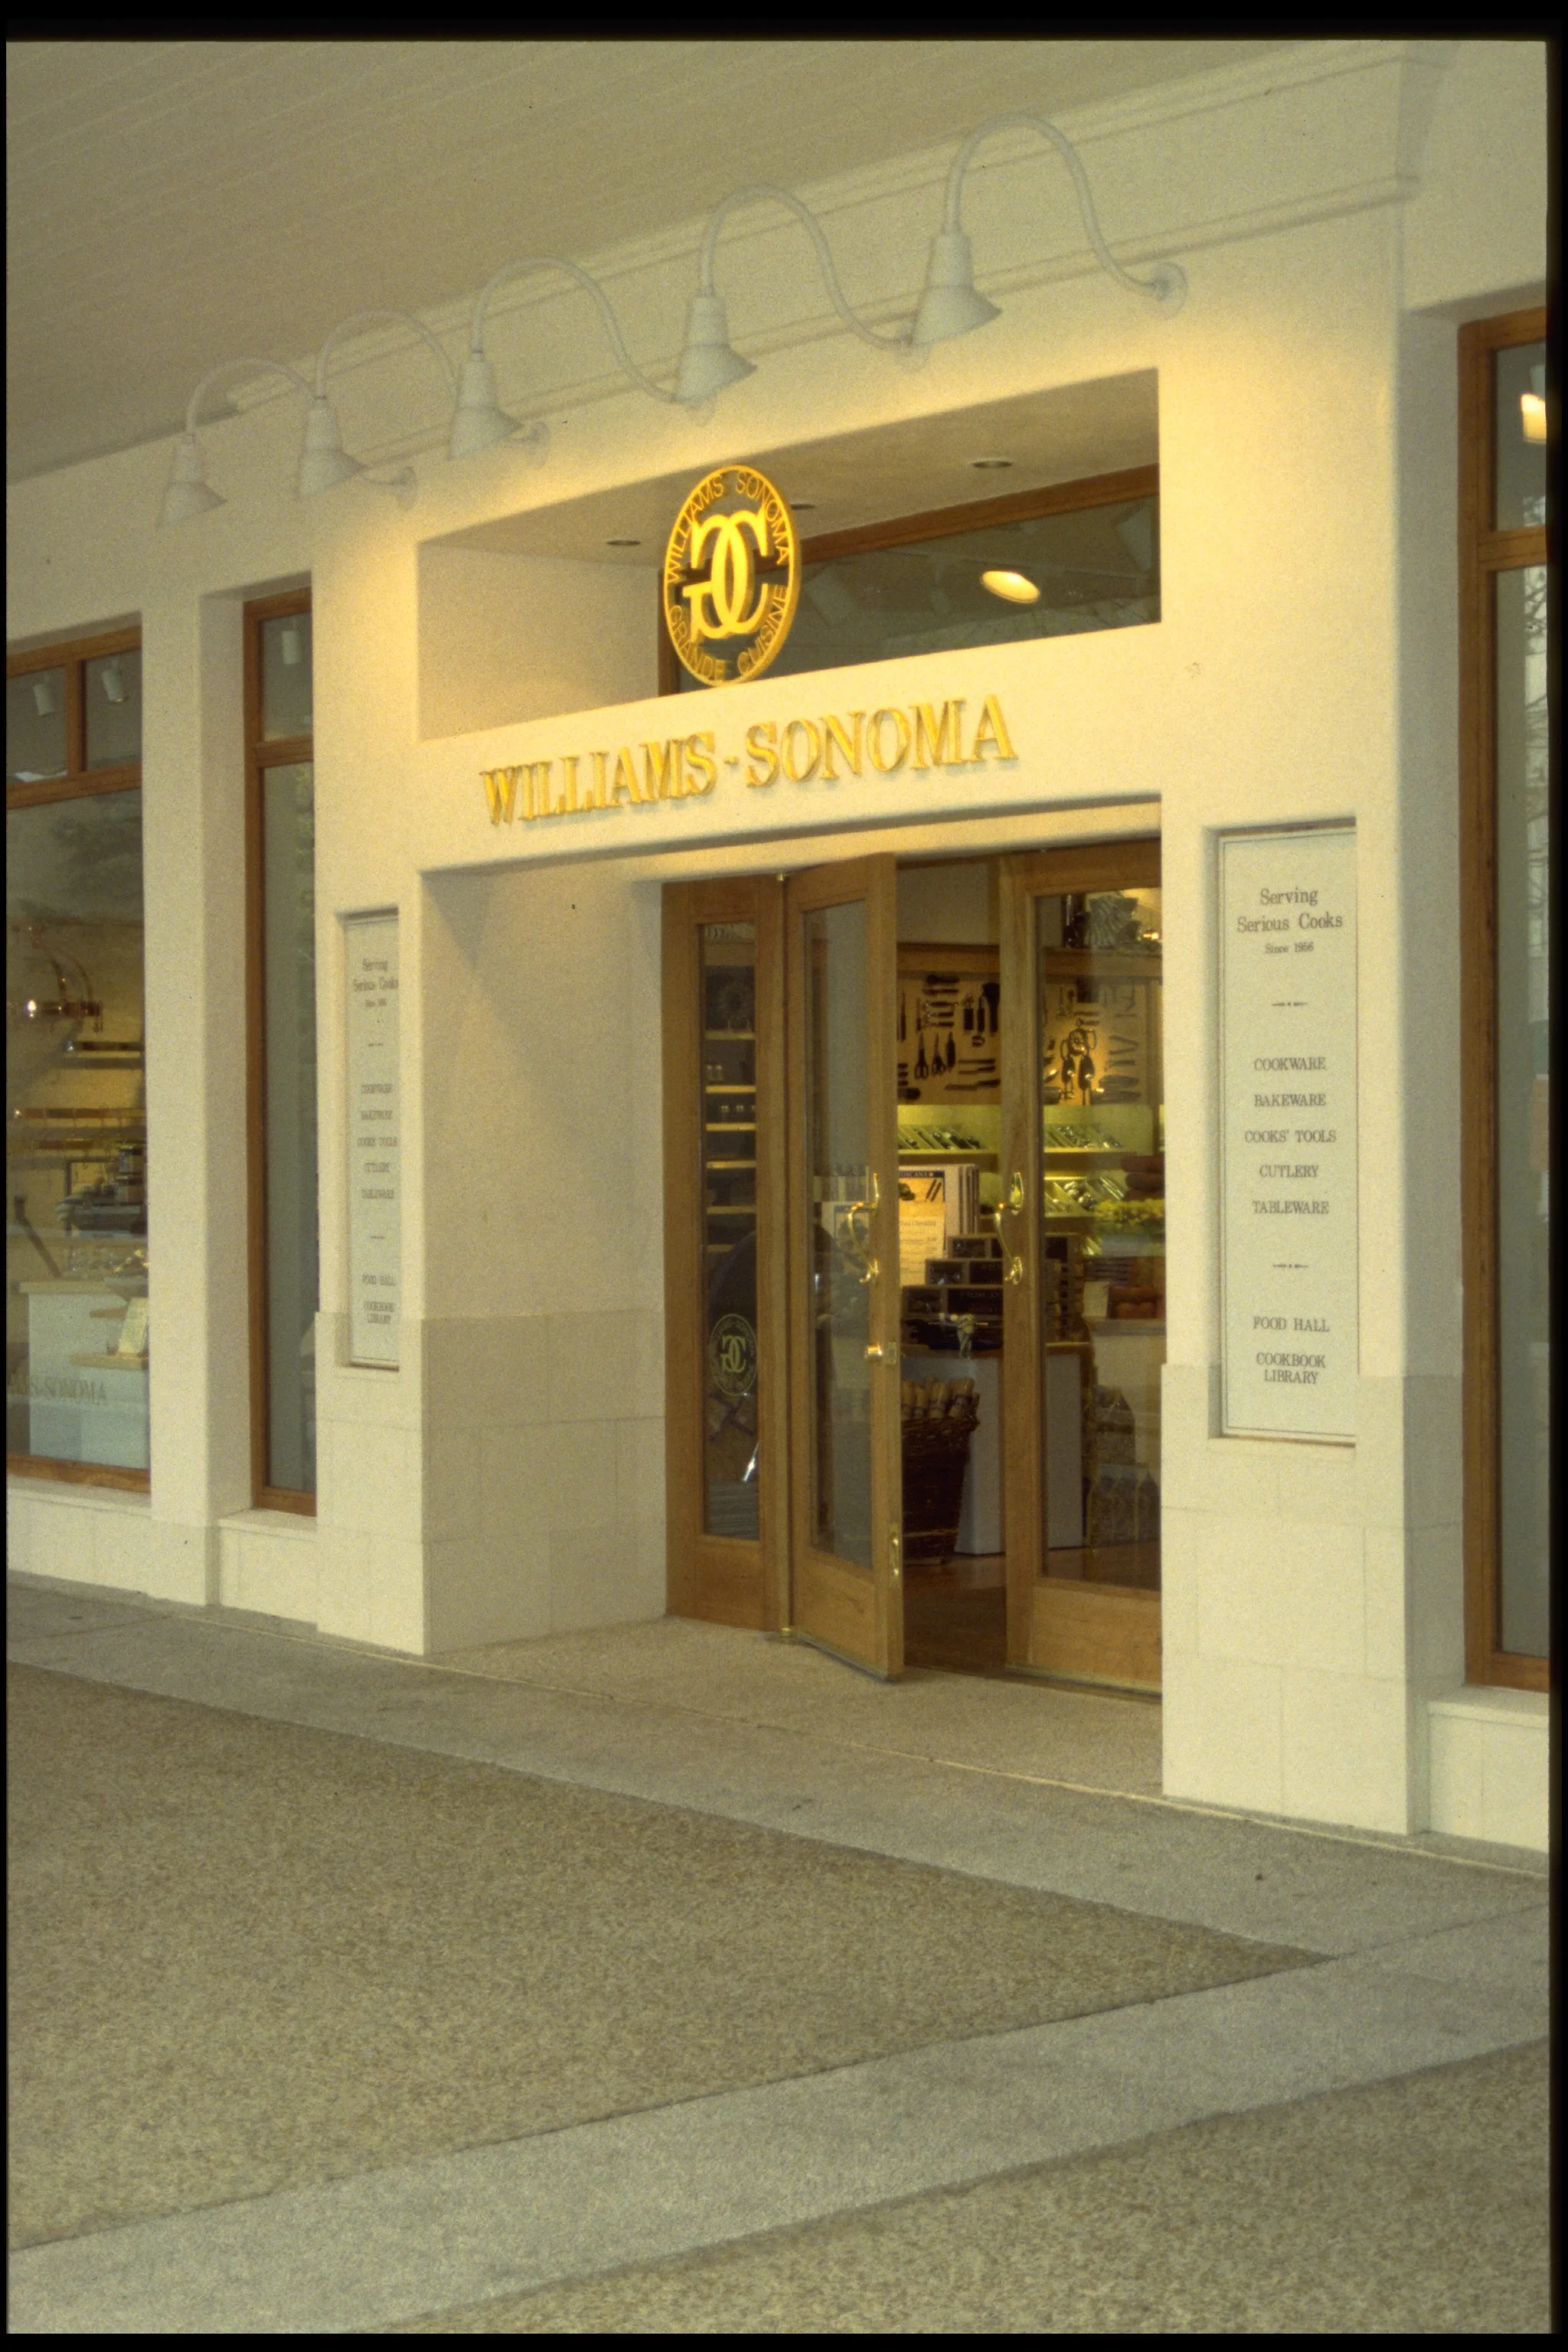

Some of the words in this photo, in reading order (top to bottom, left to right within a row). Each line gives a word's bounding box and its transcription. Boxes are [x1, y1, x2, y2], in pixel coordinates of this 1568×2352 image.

[667, 472, 724, 583] WILLIAMS
[735, 471, 790, 566] SONOMA
[668, 604, 727, 681] GRANDE
[737, 584, 787, 677] CUISINE
[1259, 886, 1319, 906] Serving
[1236, 916, 1290, 933] Serious
[1298, 911, 1343, 929] Cooks
[1254, 1057, 1326, 1070] COOKWARE
[1254, 1093, 1326, 1106] BAKEWARE
[1295, 1129, 1337, 1142] TOOLS
[1259, 1165, 1319, 1178] CUTLERY
[1253, 1200, 1330, 1214] TABLEWARE
[1253, 1315, 1287, 1330] FOOD
[1293, 1317, 1331, 1332] HALL
[1256, 1352, 1327, 1368] COOKBOOK
[1265, 1369, 1320, 1385] LIBRARY
